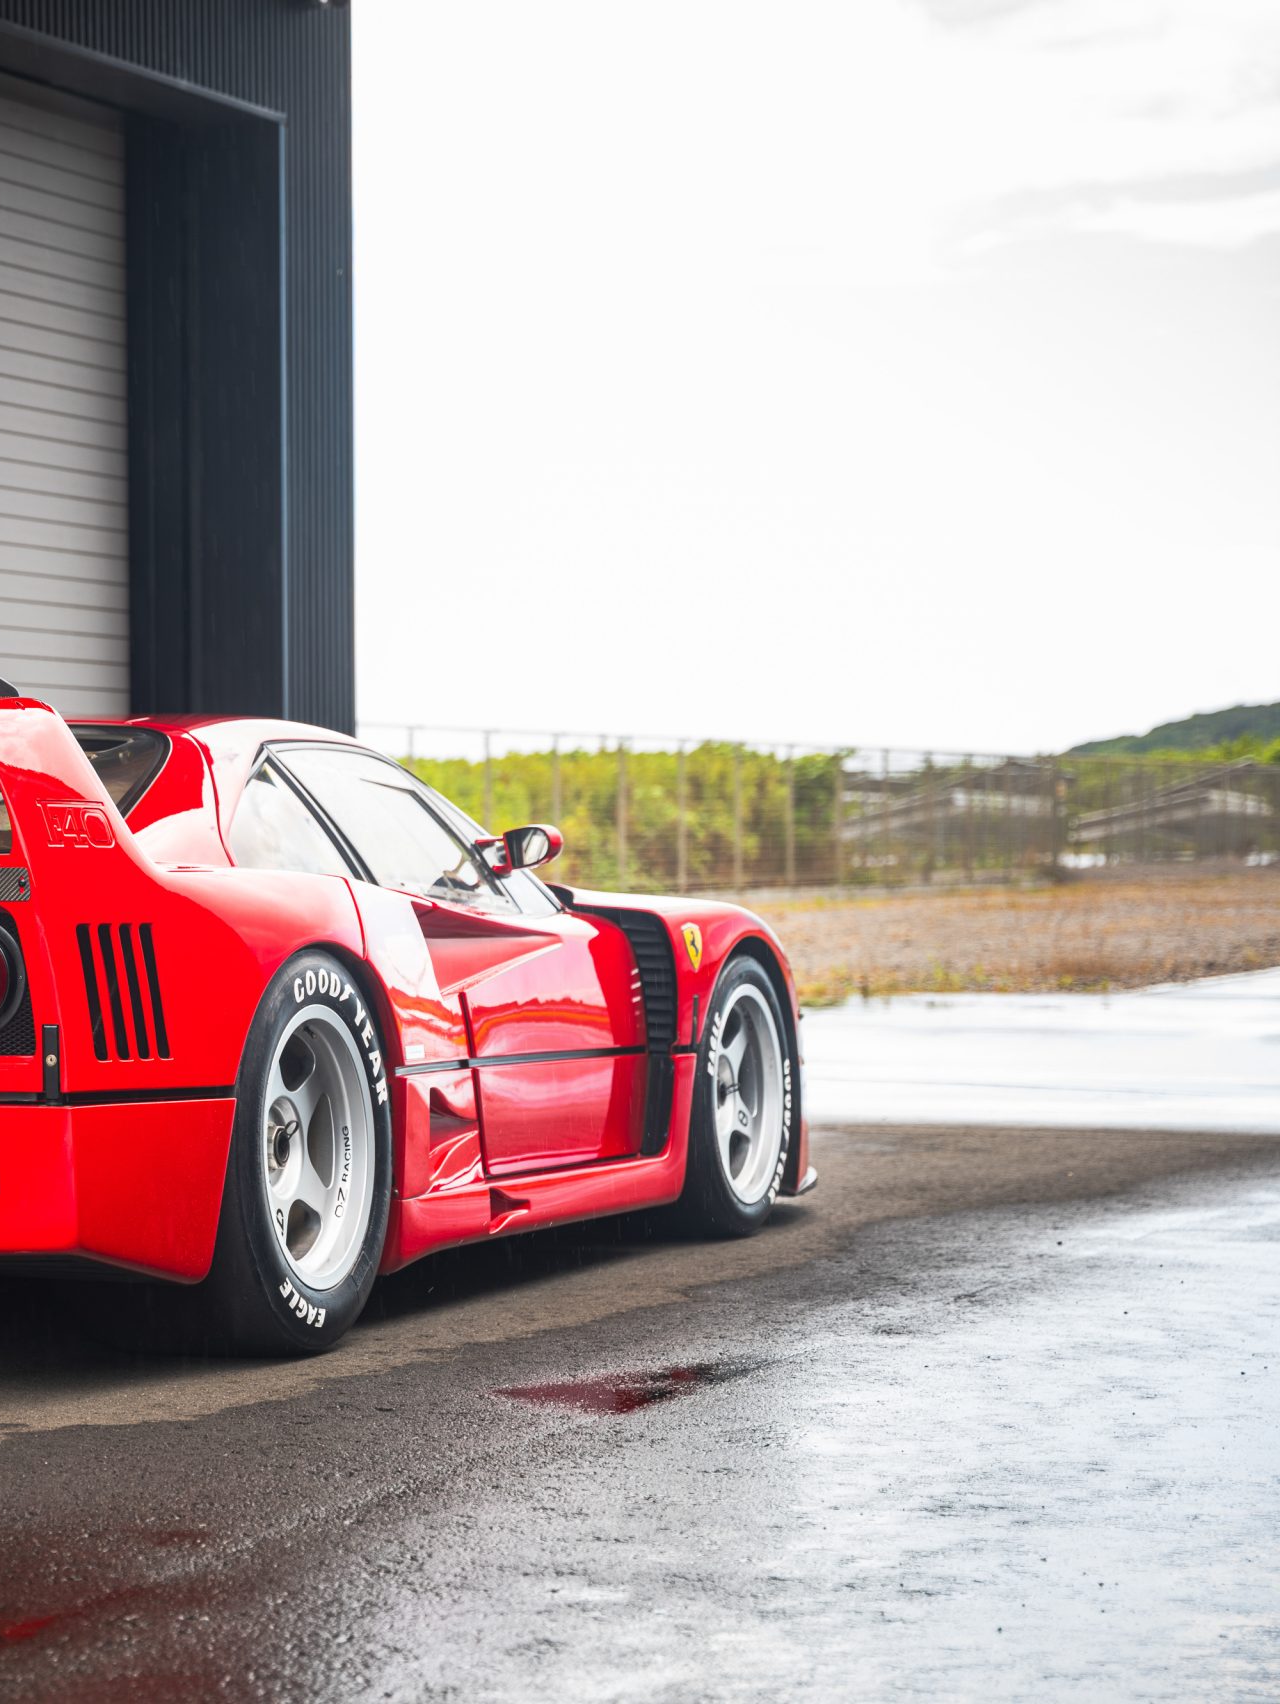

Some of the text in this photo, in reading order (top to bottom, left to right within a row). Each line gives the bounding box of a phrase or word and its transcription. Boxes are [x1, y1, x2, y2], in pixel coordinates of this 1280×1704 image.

[35, 799, 115, 848] F40
[341, 1125, 352, 1183] RACING
[279, 1277, 328, 1328] EAGLE
